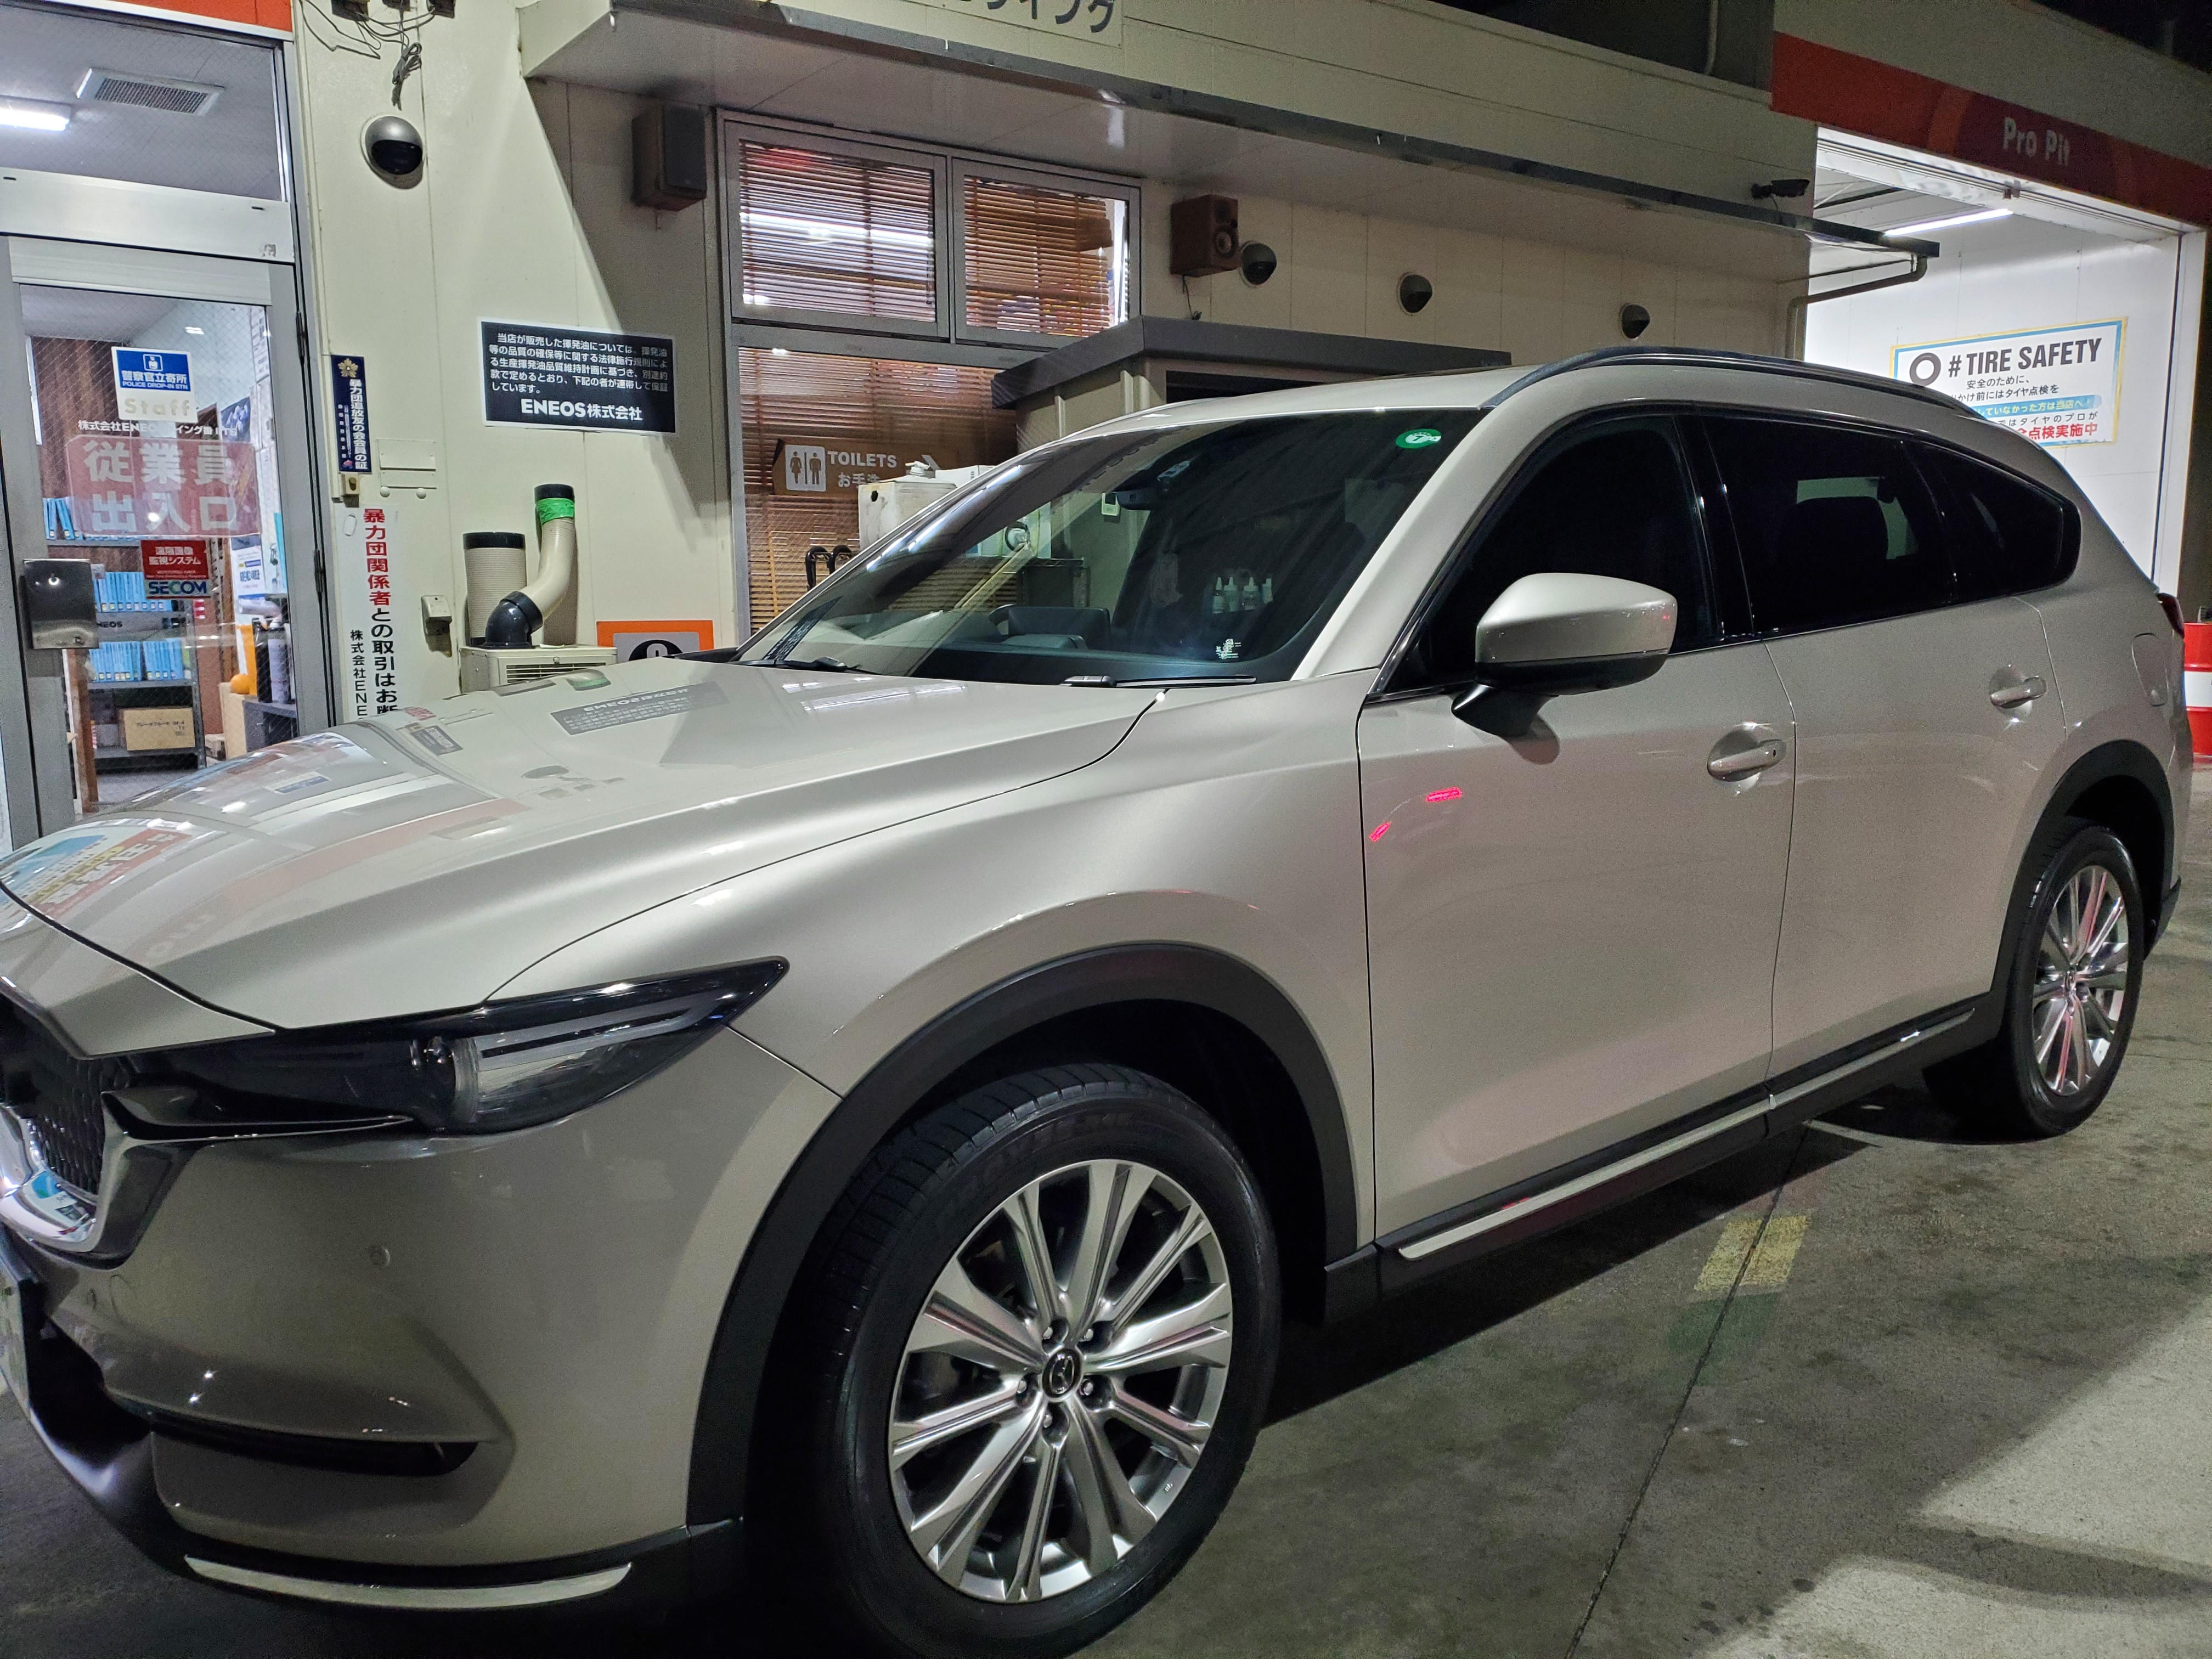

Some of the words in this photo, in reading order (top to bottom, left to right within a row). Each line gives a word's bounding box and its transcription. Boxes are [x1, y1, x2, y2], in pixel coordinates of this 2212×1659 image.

[2004, 117, 2037, 157] Pro
[2045, 129, 2070, 166] Pit
[2018, 338, 2102, 370] SAFETY
[121, 370, 187, 384] 警察官立寄所
[1967, 375, 2029, 390] 安全のために、
[492, 382, 541, 394] しています。
[1951, 385, 2059, 402] かけ前にはタイヤ点検を
[125, 398, 190, 416] Staff
[521, 398, 643, 421] ENEOS株式会社
[83, 439, 237, 485] 従業員
[827, 450, 898, 468] TOILETS
[92, 490, 240, 533] 出入口
[149, 581, 207, 594] SECOM
[350, 629, 368, 719] 株式会社ENE
